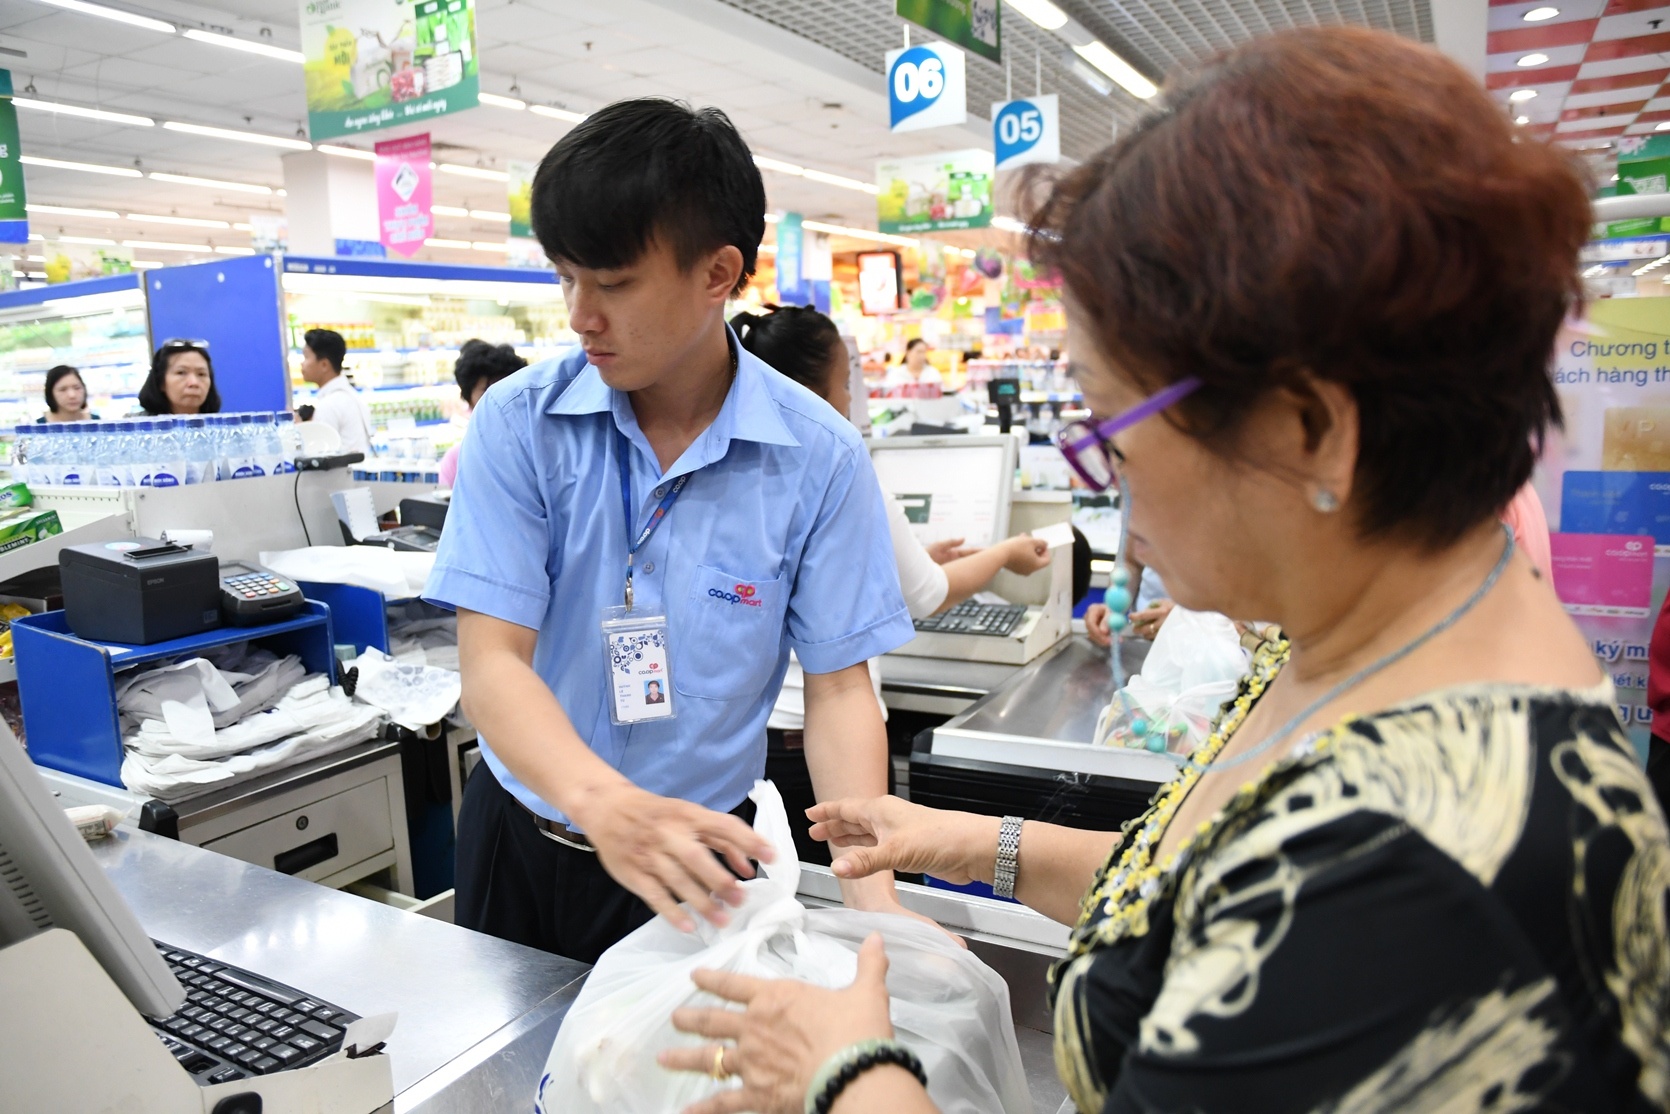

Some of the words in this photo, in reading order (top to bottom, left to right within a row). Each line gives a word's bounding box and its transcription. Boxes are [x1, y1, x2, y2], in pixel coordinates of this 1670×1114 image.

[894, 57, 944, 103] 06
[1000, 110, 1041, 145] 05
[1570, 340, 1657, 360] Chương
[1597, 366, 1648, 387] hàng
[1596, 640, 1619, 659] ký
